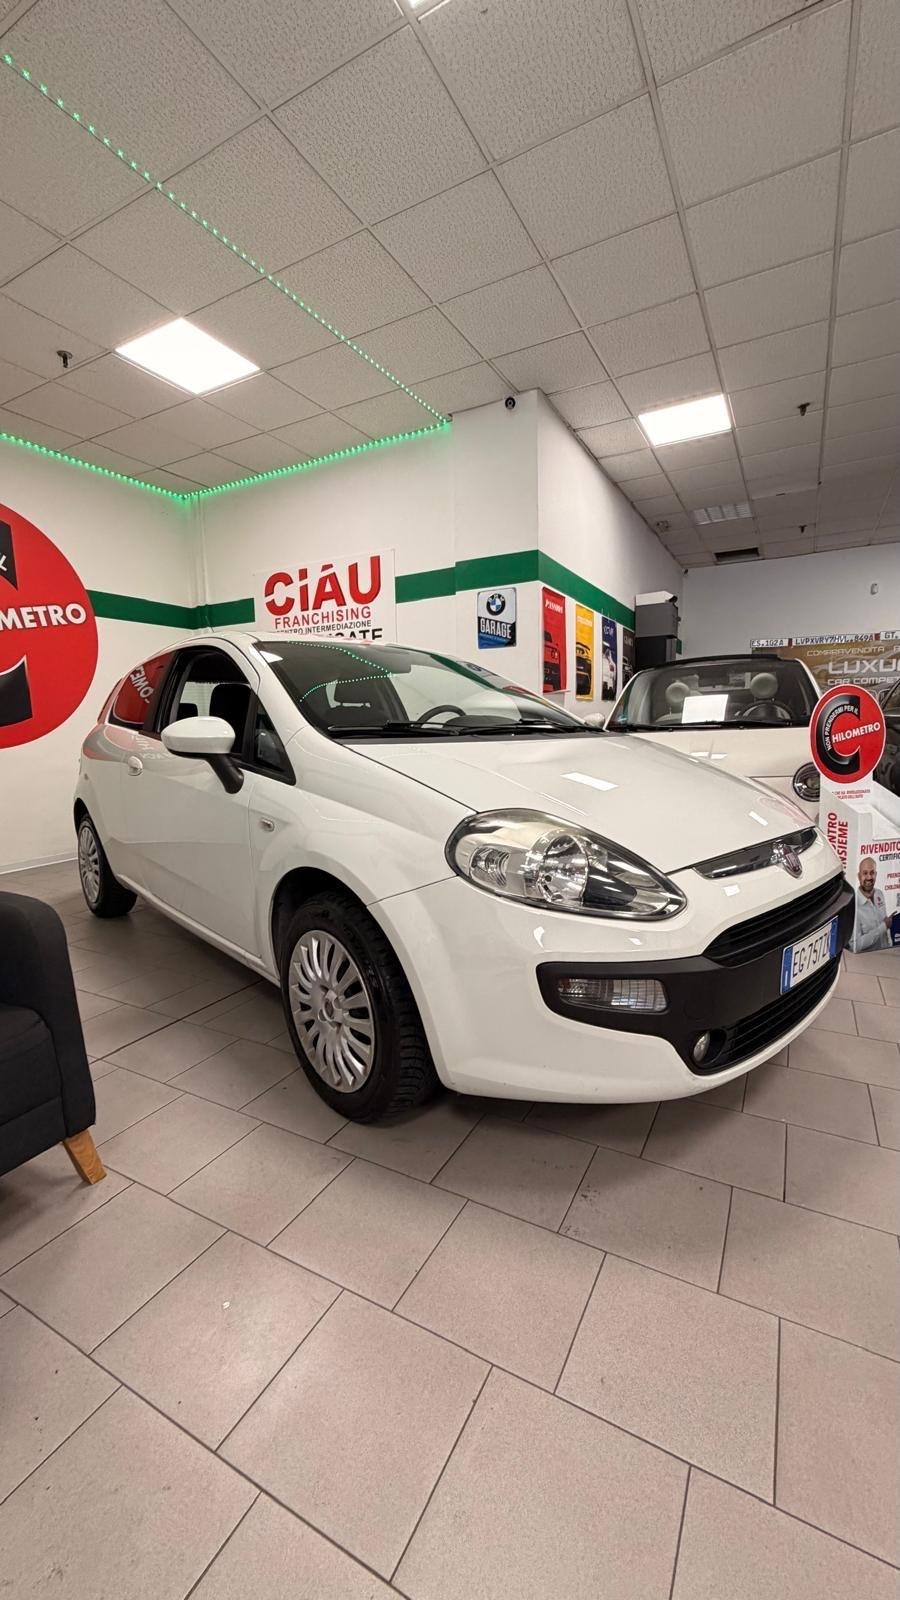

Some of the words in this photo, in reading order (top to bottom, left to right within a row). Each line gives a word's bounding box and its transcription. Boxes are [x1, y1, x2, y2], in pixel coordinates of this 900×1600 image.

[275, 606, 371, 630] FRANCHISING
[305, 619, 372, 635] INTERMEDIAZIONE
[480, 618, 512, 639] GARAGE
[828, 658, 900, 674] LUXU
[828, 678, 850, 686] CAR
